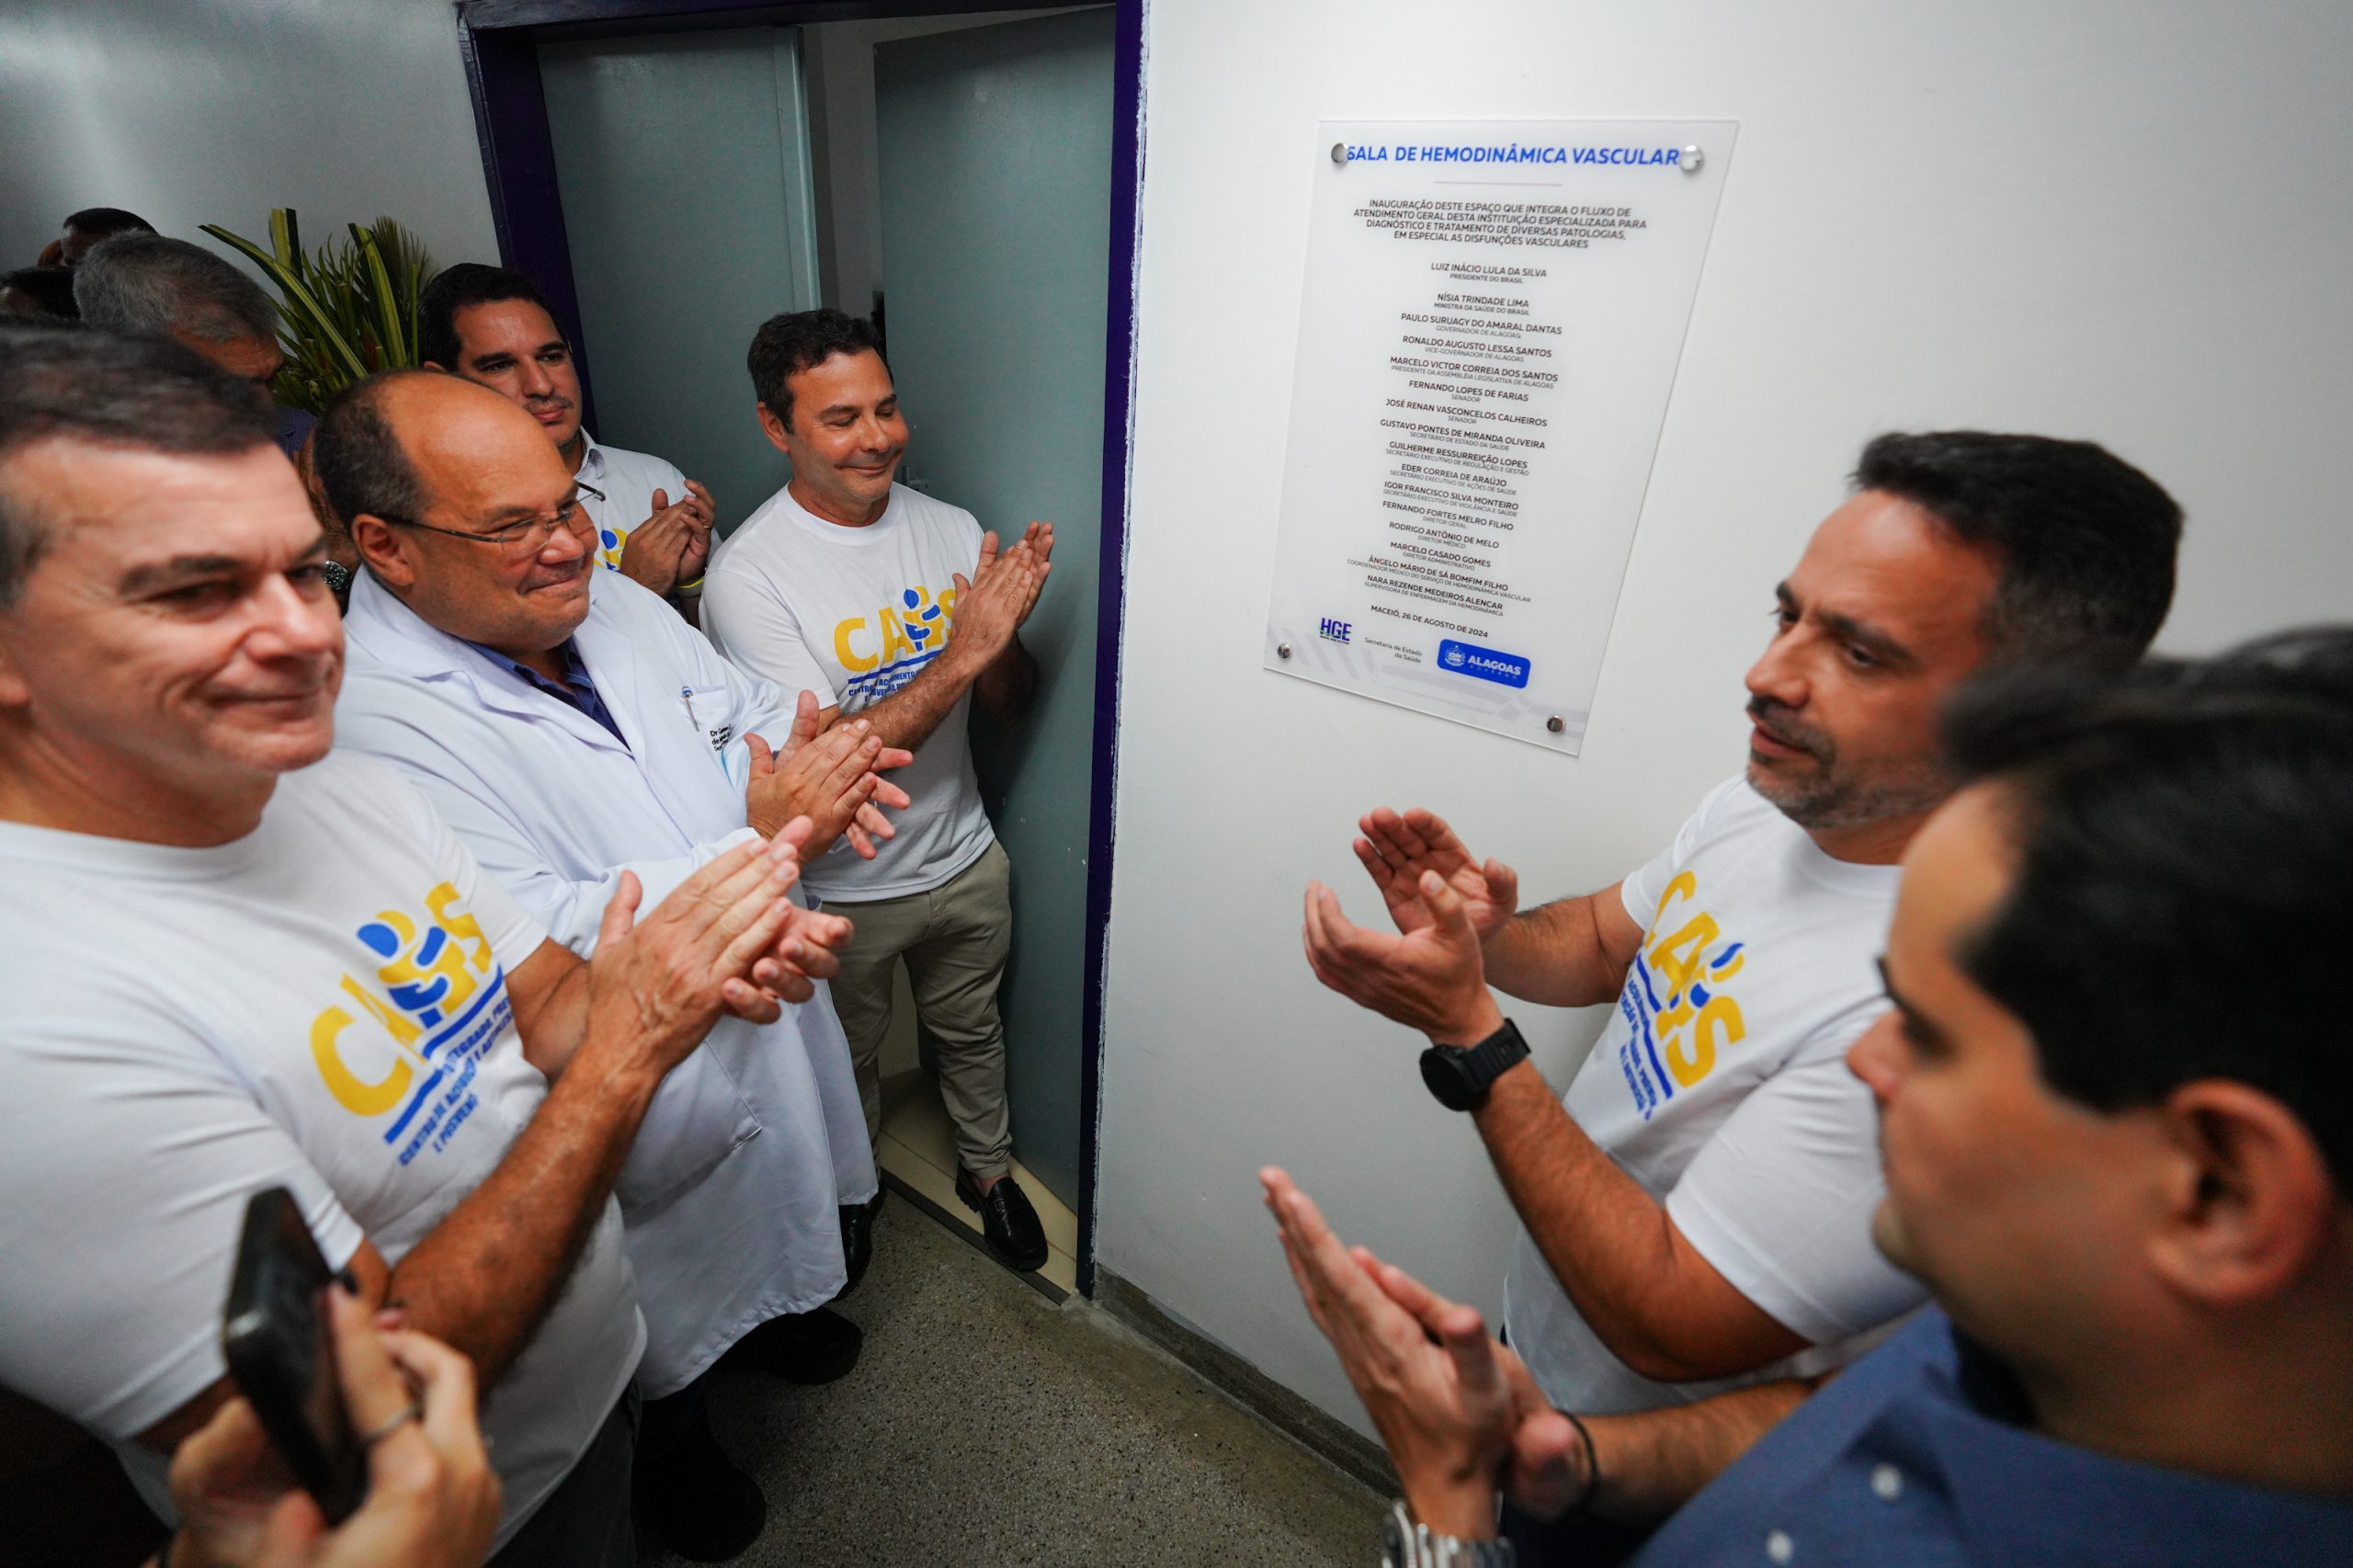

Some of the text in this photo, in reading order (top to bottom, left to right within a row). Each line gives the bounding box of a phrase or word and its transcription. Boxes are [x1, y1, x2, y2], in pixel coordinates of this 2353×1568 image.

[1347, 143, 1680, 164] SALA DE HEMODINÂMICA VASCULAR
[1354, 209, 1647, 228] ATENDIMENTO GERAL DESTA INSTITUIÇÃO ESPECIALIZADA PARA
[1370, 199, 1433, 210] INAUGURAÇÃO
[1435, 202, 1462, 210] DESTE
[1464, 203, 1502, 213] ESPAÇO
[1503, 204, 1524, 212] QUE
[1526, 205, 1568, 214] INTEGRA
[1580, 207, 1615, 216] FLUXO
[1617, 208, 1631, 216] DE
[1366, 219, 1425, 230] DIAGNÓSTICO
[1426, 222, 1431, 231] E
[1434, 223, 1495, 233] TRATAMENTO
[1511, 226, 1559, 236] DIVERSAS
[1560, 229, 1625, 240] PATOLOGIAS,
[1393, 231, 1589, 248] EM ESPECIAL AS DISFUNÇÕES VASCULARES
[1451, 263, 1482, 272] INÁCIO
[1483, 266, 1506, 274] LULA
[1438, 292, 1529, 307] NÍSIA TRINDADE LIMA
[1401, 313, 1428, 323] PAULO
[1430, 316, 1469, 325] SURUAGY
[1486, 321, 1524, 330] AMARAL
[1526, 324, 1563, 334] DANTAS
[1403, 336, 1552, 356] RONALDO AUGUSTO LESSA SANTOS
[1390, 357, 1558, 381] MARCELO VICTOR CORREIA DOS SANTOS
[1409, 381, 1529, 401] FERNANDO LOPES DE FARIAS
[1386, 399, 1548, 426] JOSÉ RENAN VASCONCELOS CALHEIROS
[1381, 419, 1416, 430] GUSTAVO
[1417, 425, 1449, 435] PONTES
[1463, 430, 1504, 442] MIRANDA
[1505, 437, 1545, 448] OLIVEIRA
[1390, 441, 1528, 467] GUILHERME RESSURREIÇÃO LOPES
[1401, 464, 1507, 486] EDER CORREIA DE ARAÚJO
[1384, 481, 1518, 509] IGOR FRANCISCO SILVA MONTEIRO
[1382, 501, 1514, 529] FERNANDO FORTES MELRO FILHO
[1389, 522, 1425, 535] RODRIGO
[1463, 535, 1474, 543] DE
[1476, 538, 1499, 548] MELO
[1390, 541, 1491, 566] MARCELO CASADO GOMES
[1369, 553, 1508, 590] ÂNGELO MÁRIO DE SÁ BOMFIM FILHO
[1368, 574, 1503, 609] NARA REZENDE MEDEIROS ALENCAR
[1320, 618, 1352, 642] HGE
[1371, 605, 1400, 619] MACEIÓ,
[1412, 614, 1422, 622] DE
[1424, 617, 1455, 630] AGOSTO
[1456, 624, 1467, 632] DE
[1468, 627, 1488, 637] 2024
[1468, 655, 1521, 675] ALAGOAS
